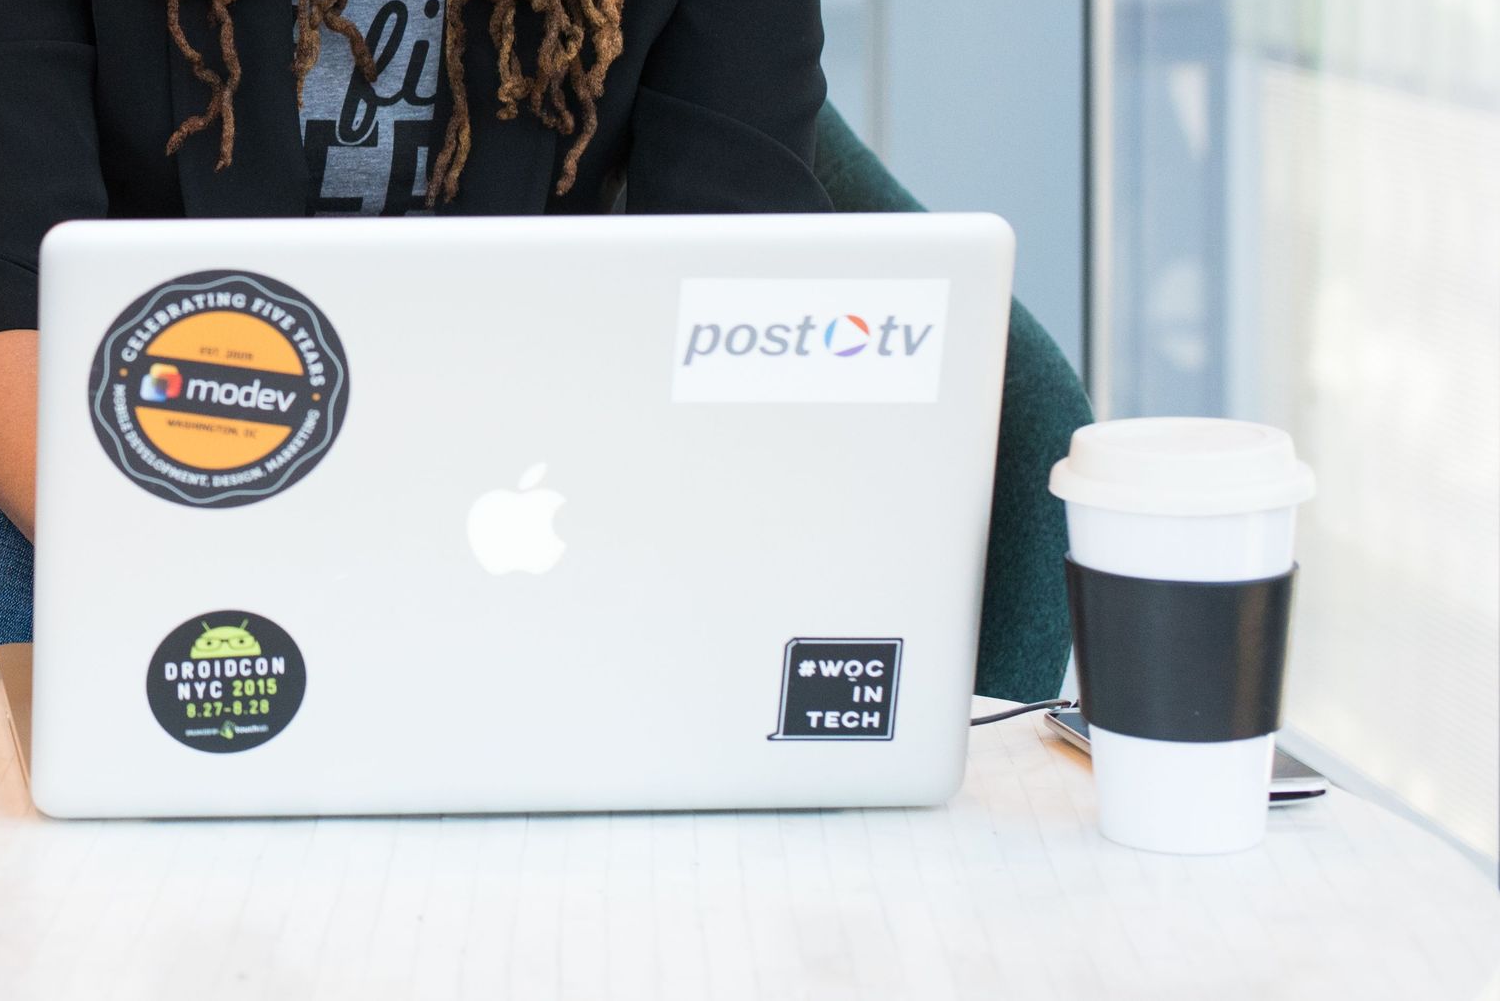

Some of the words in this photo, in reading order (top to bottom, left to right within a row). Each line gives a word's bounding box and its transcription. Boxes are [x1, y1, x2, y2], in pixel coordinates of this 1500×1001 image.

[121, 292, 247, 363] CELEBRATING
[251, 297, 296, 331] FIVE
[291, 326, 326, 388] YEARS
[682, 314, 817, 366] post
[876, 315, 934, 357] tv
[186, 377, 297, 413] modev
[113, 383, 133, 433] MOBILE
[125, 430, 210, 487] DEVELOPMENT,
[211, 466, 267, 488] DESIGN,
[264, 408, 321, 474] MARKETING
[164, 657, 285, 681] DROIDCON
[177, 680, 223, 701] NYC
[232, 678, 278, 697] 2015
[852, 685, 883, 703] IN
[186, 699, 270, 718] 8.27-8.28
[806, 711, 881, 729] TECH
